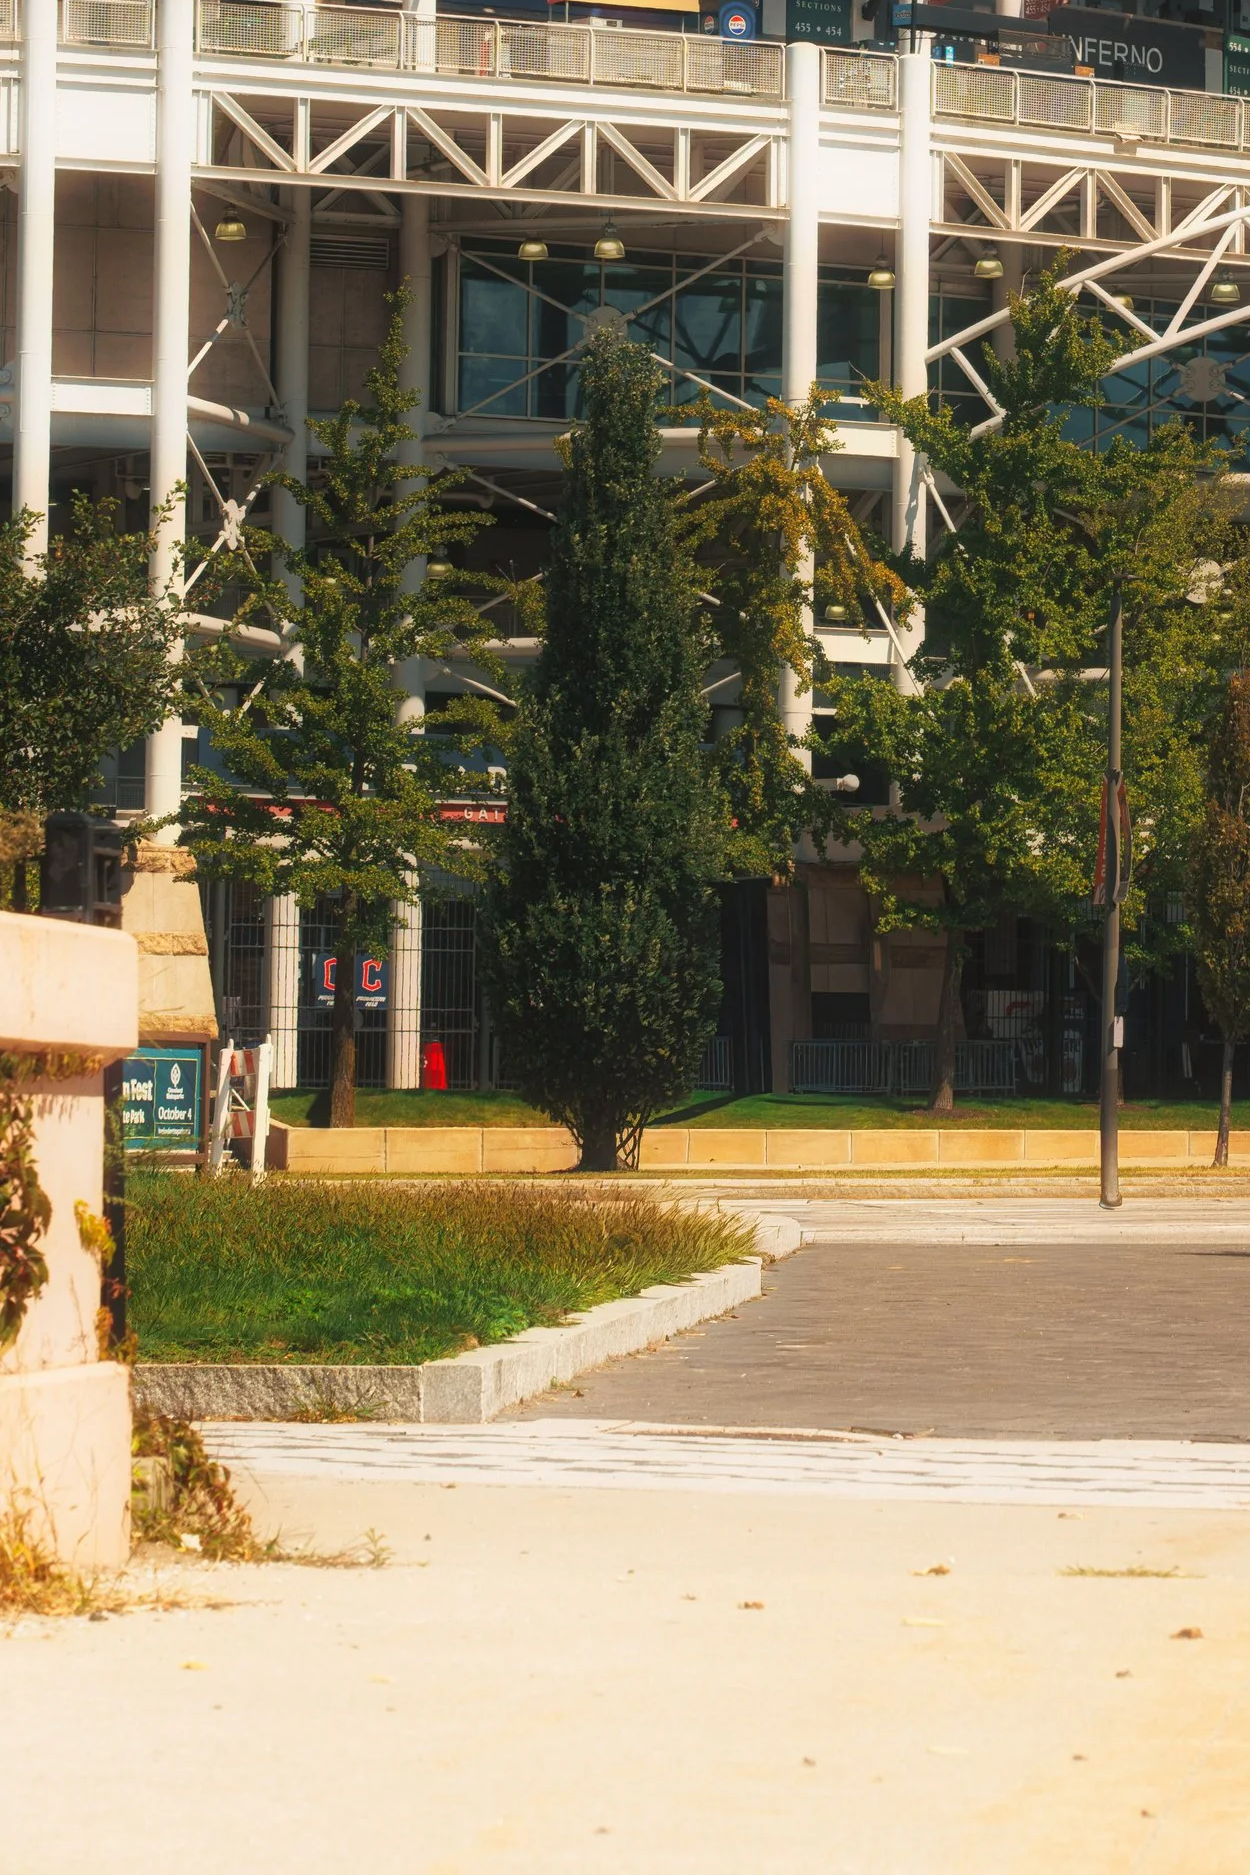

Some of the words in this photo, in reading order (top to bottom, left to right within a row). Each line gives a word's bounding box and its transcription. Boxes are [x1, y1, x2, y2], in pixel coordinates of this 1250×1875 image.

[795, 0, 842, 13] SECTIONS
[795, 22, 811, 33] 455
[825, 25, 842, 37] 454
[1063, 34, 1163, 73] NFERNO
[1229, 41, 1243, 52] 554
[1229, 86, 1241, 96] 454
[464, 806, 509, 820] GAT
[130, 1078, 154, 1102] Fest
[130, 1108, 145, 1124] Park
[157, 1106, 187, 1121] October
[187, 1108, 192, 1121] 4
